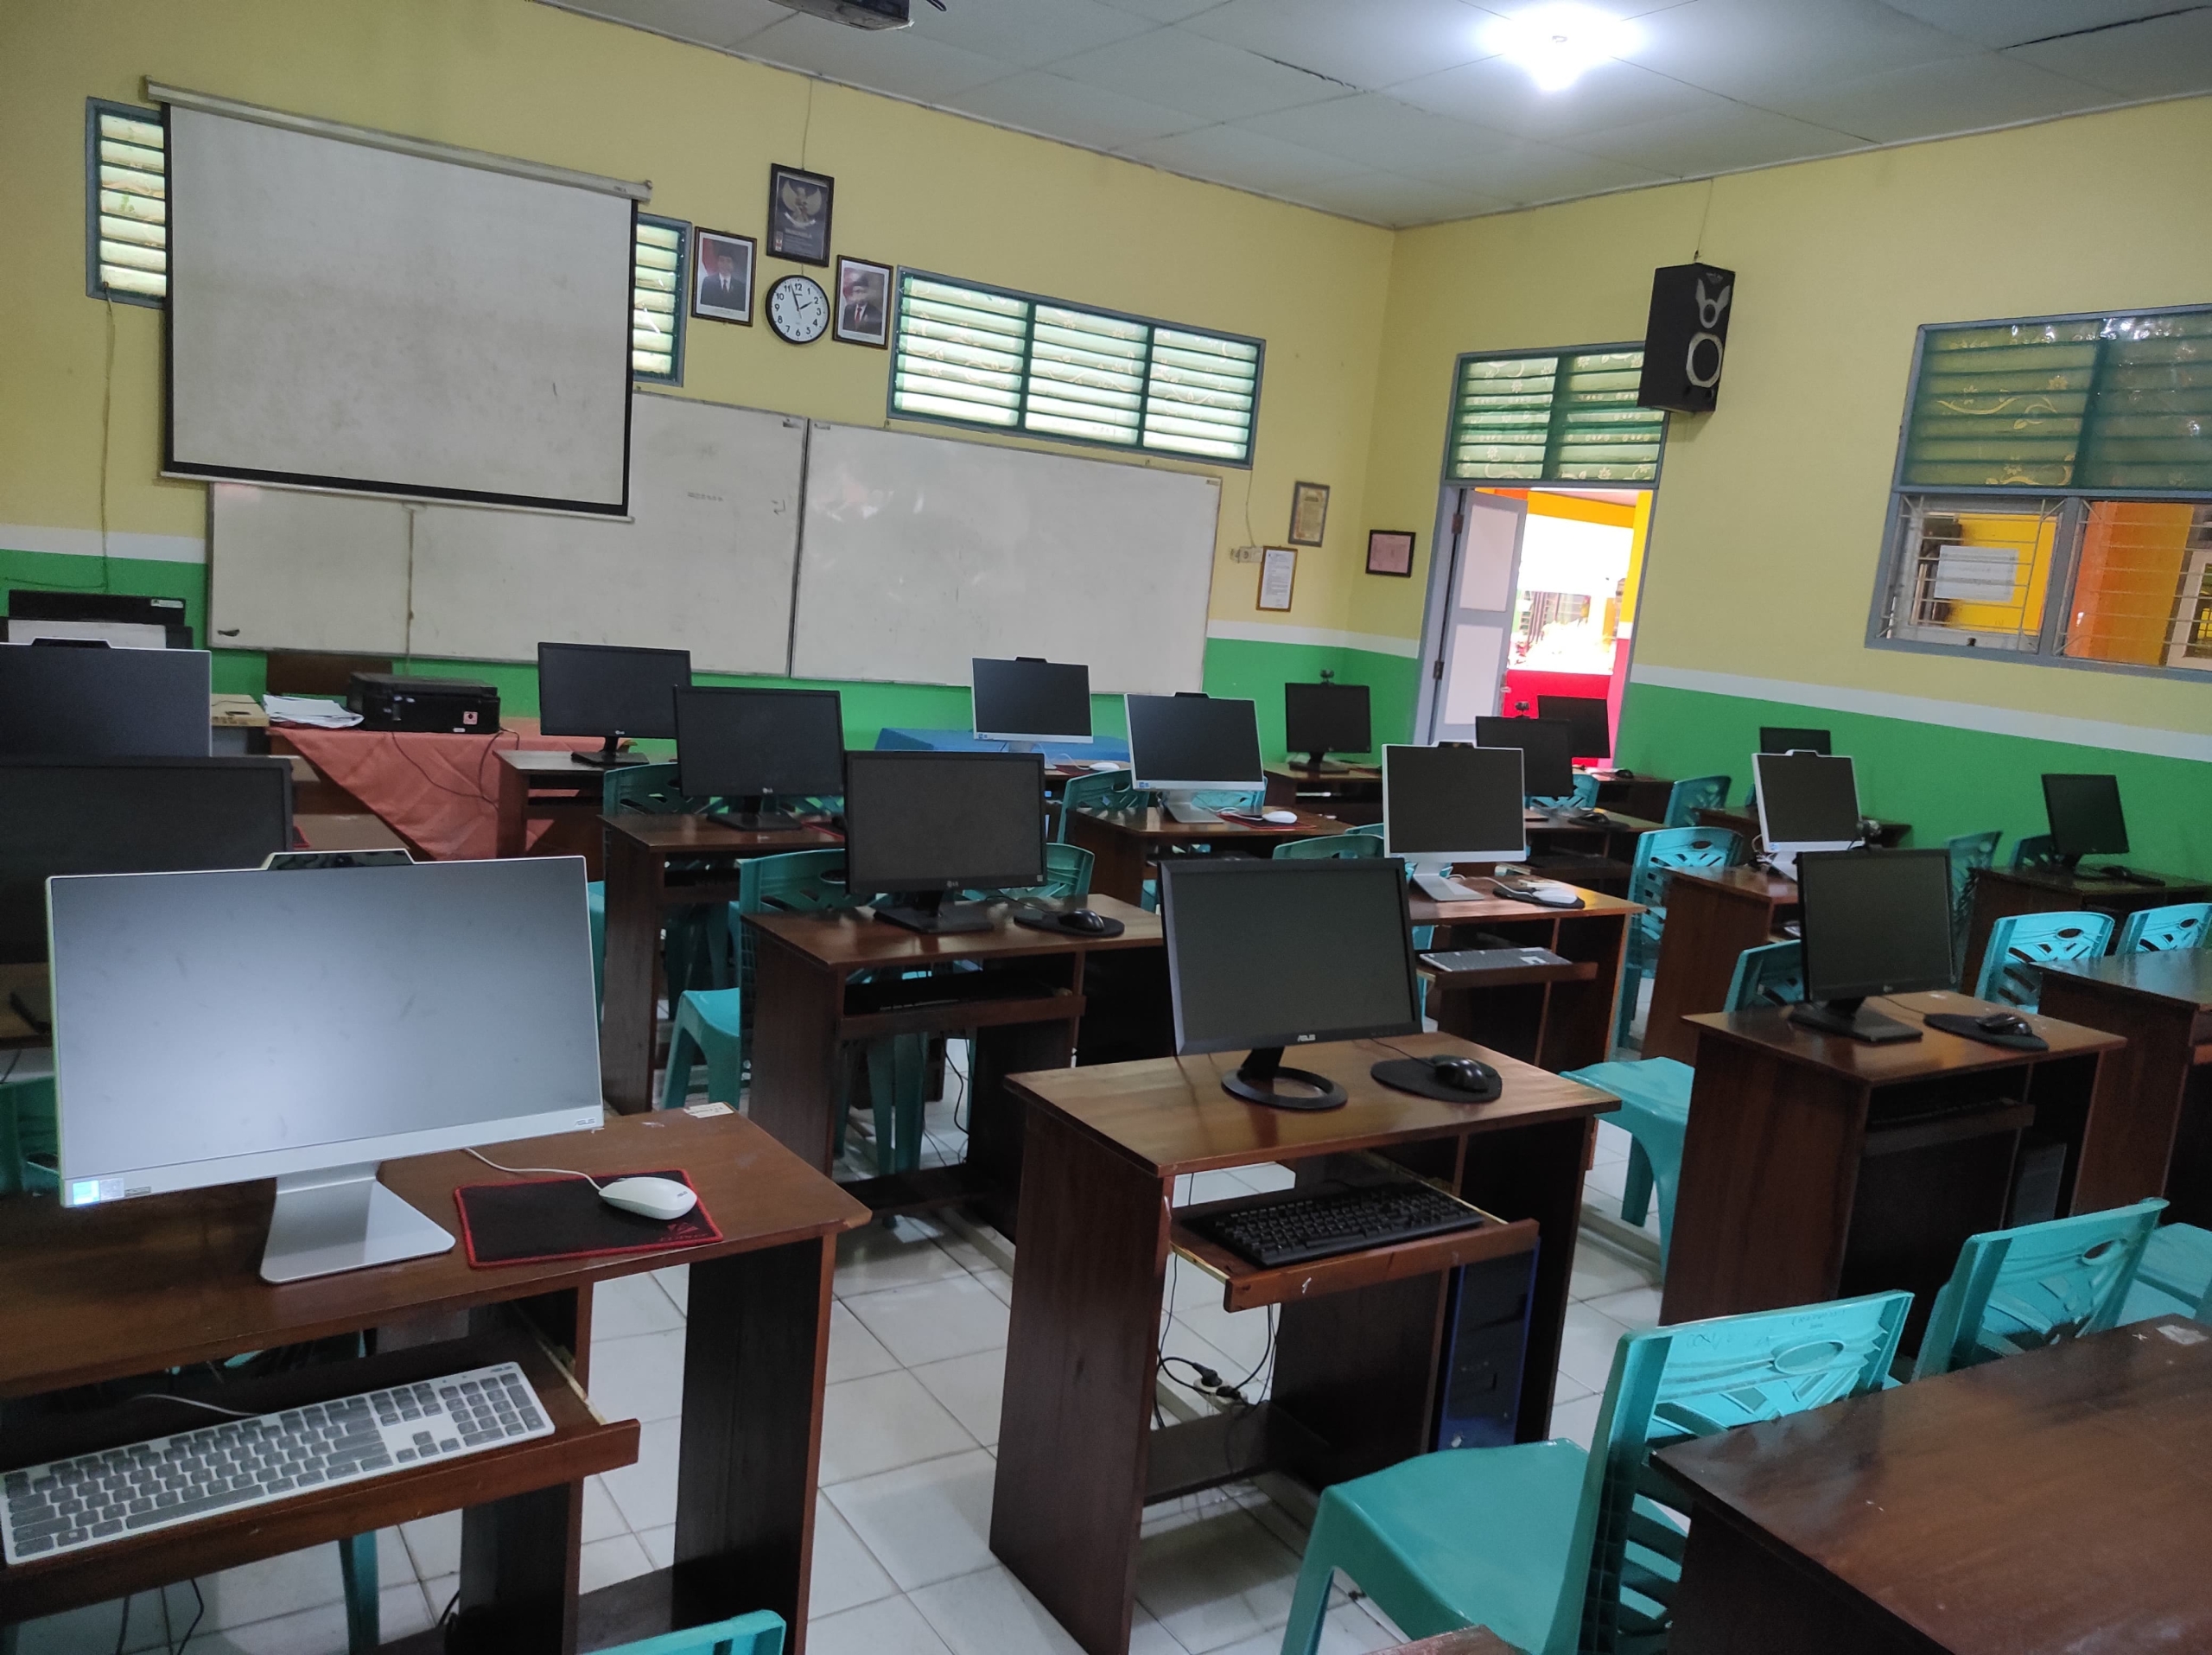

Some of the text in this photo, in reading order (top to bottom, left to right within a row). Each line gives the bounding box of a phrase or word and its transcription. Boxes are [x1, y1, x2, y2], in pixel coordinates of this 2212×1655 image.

[794, 283, 803, 291] 12
[774, 303, 780, 312] 9
[778, 315, 783, 323] 8
[812, 318, 818, 327] 4
